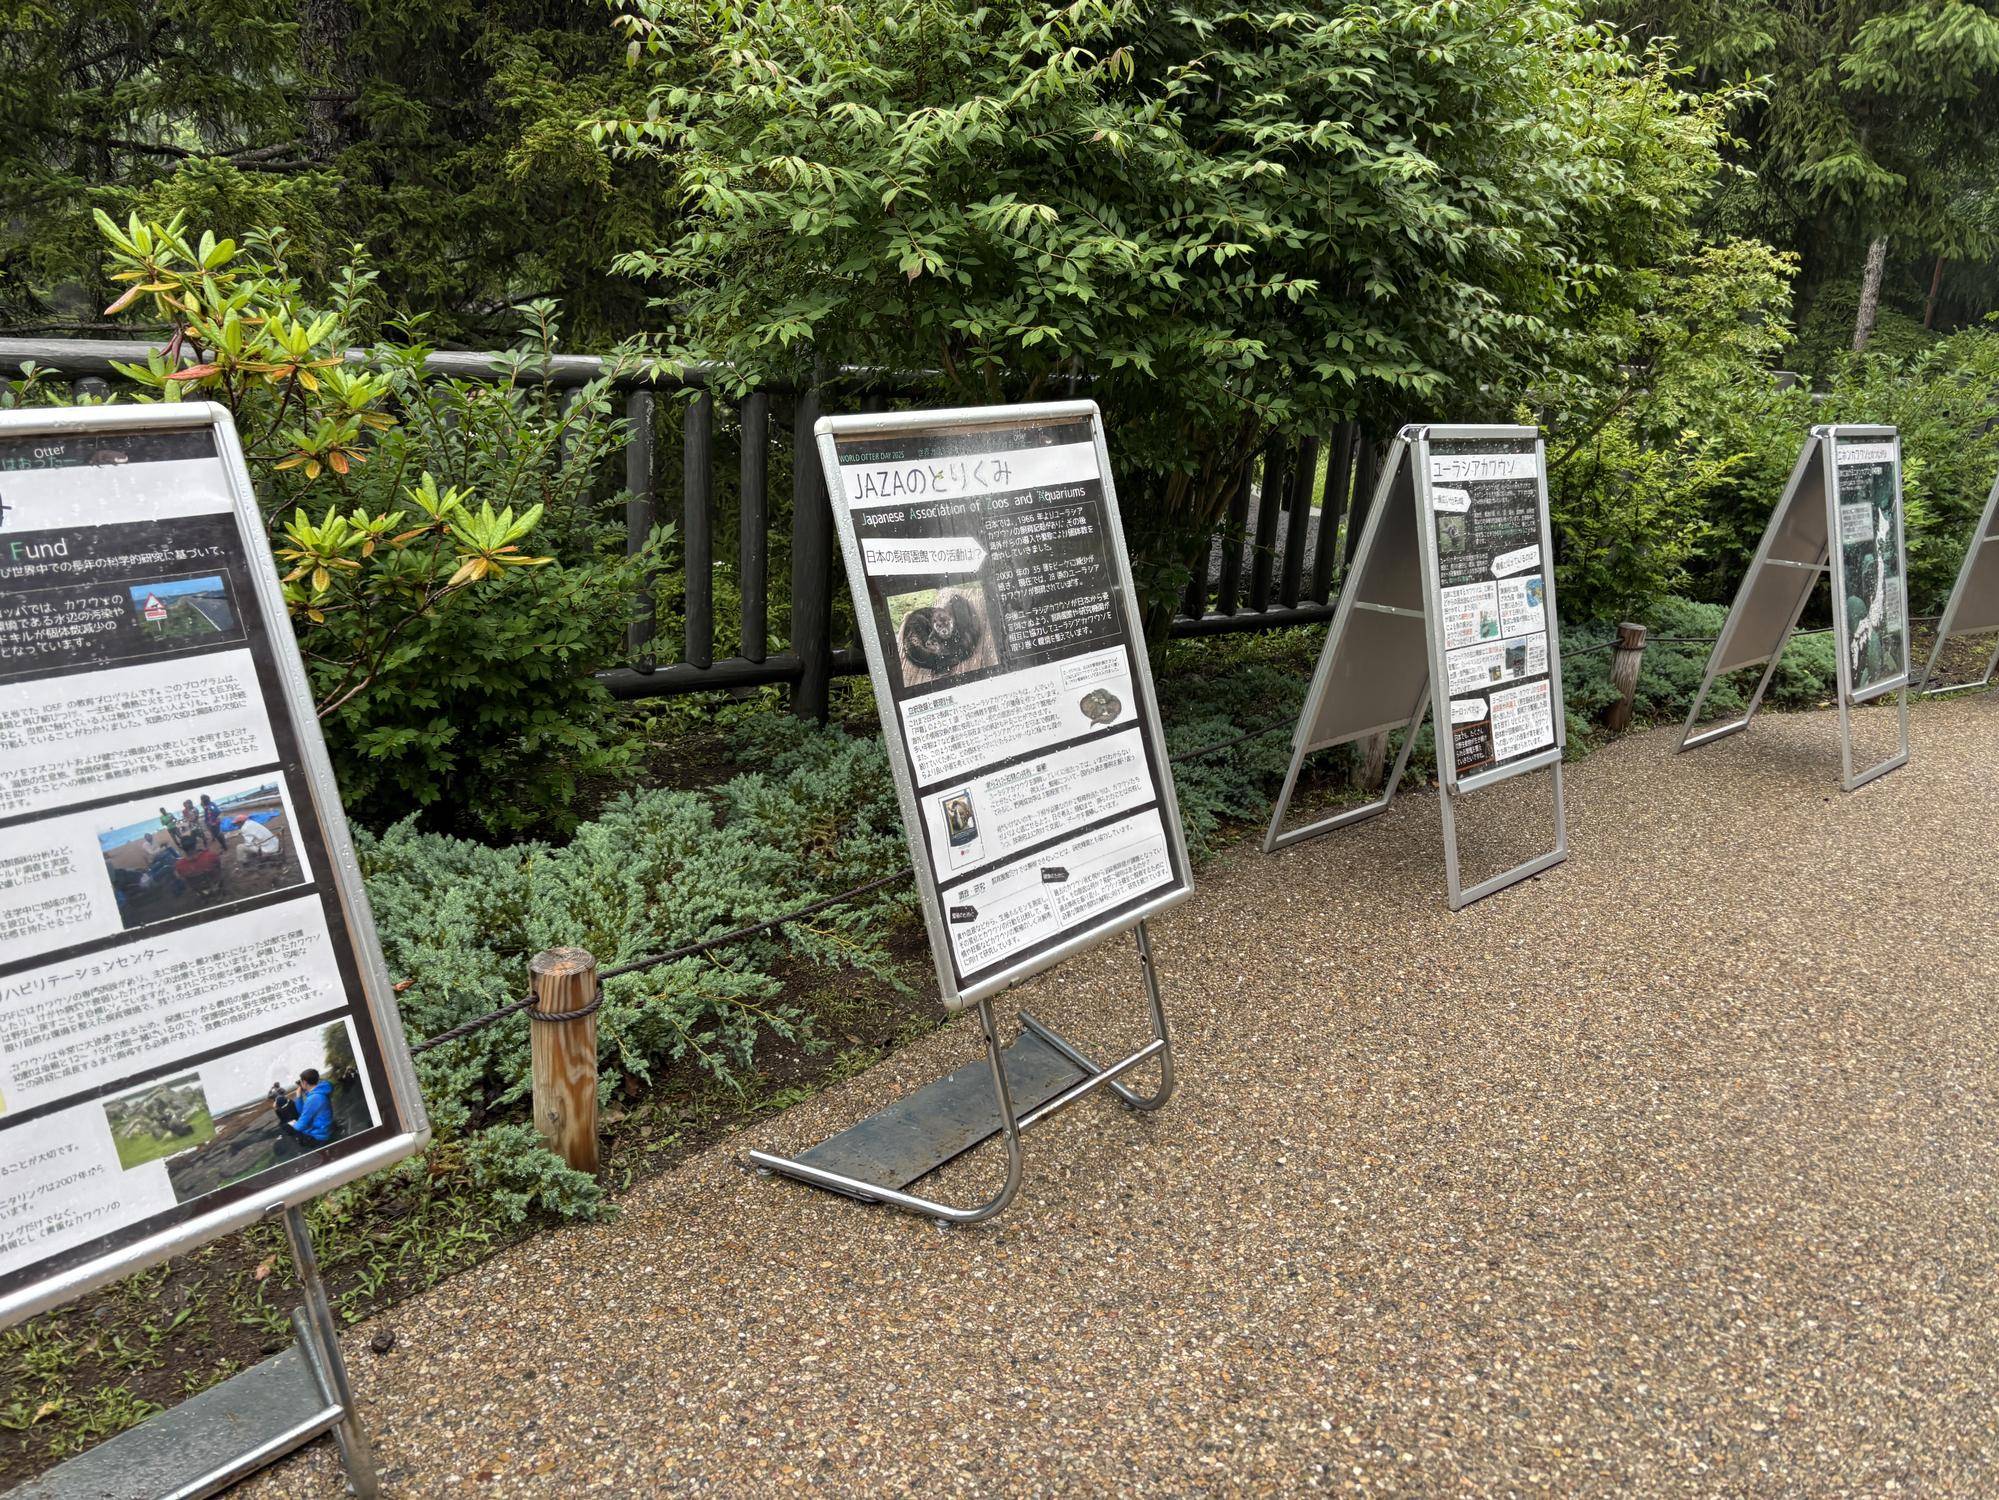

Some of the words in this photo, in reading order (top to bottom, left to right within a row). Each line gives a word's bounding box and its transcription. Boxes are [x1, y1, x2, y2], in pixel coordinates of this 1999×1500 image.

[34, 445, 65, 459] Otter
[839, 453, 860, 463] WORLD
[861, 452, 878, 462] OTTER
[879, 451, 892, 461] DAY
[1433, 459, 1515, 477] ユーラシアカワウソ
[855, 460, 1013, 500] JAZAのとりくみ
[859, 507, 905, 528] Japanese
[968, 500, 980, 512] of
[1013, 492, 1033, 506] and
[10, 538, 68, 561] Fund
